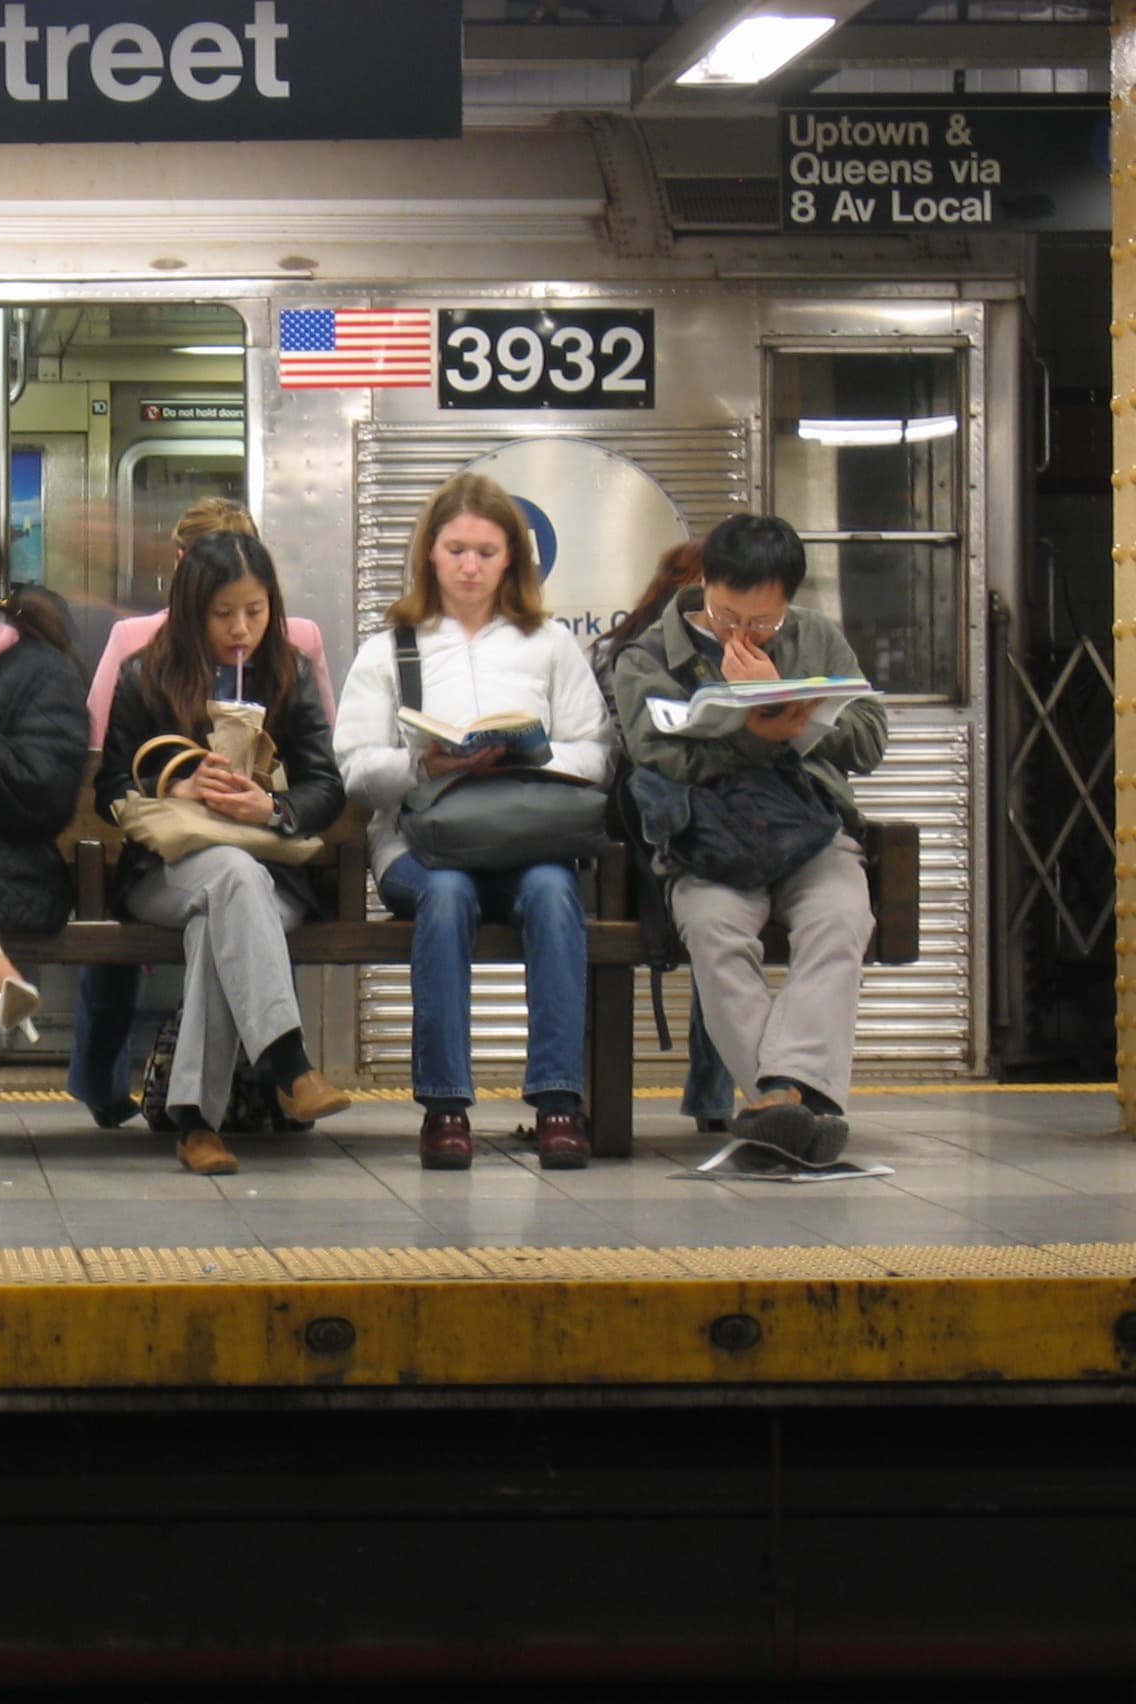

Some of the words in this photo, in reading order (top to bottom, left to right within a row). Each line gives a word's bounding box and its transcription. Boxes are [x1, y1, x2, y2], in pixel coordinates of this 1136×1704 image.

[788, 114, 930, 152] Uptown
[945, 113, 973, 146] &
[789, 152, 934, 185] Queens
[949, 152, 1001, 184] via
[790, 190, 816, 223] 8
[831, 190, 876, 223] Av
[891, 190, 992, 223] Local
[446, 326, 647, 393] 3932
[162, 407, 177, 417] Do
[178, 407, 194, 417] not
[195, 407, 217, 418] hold
